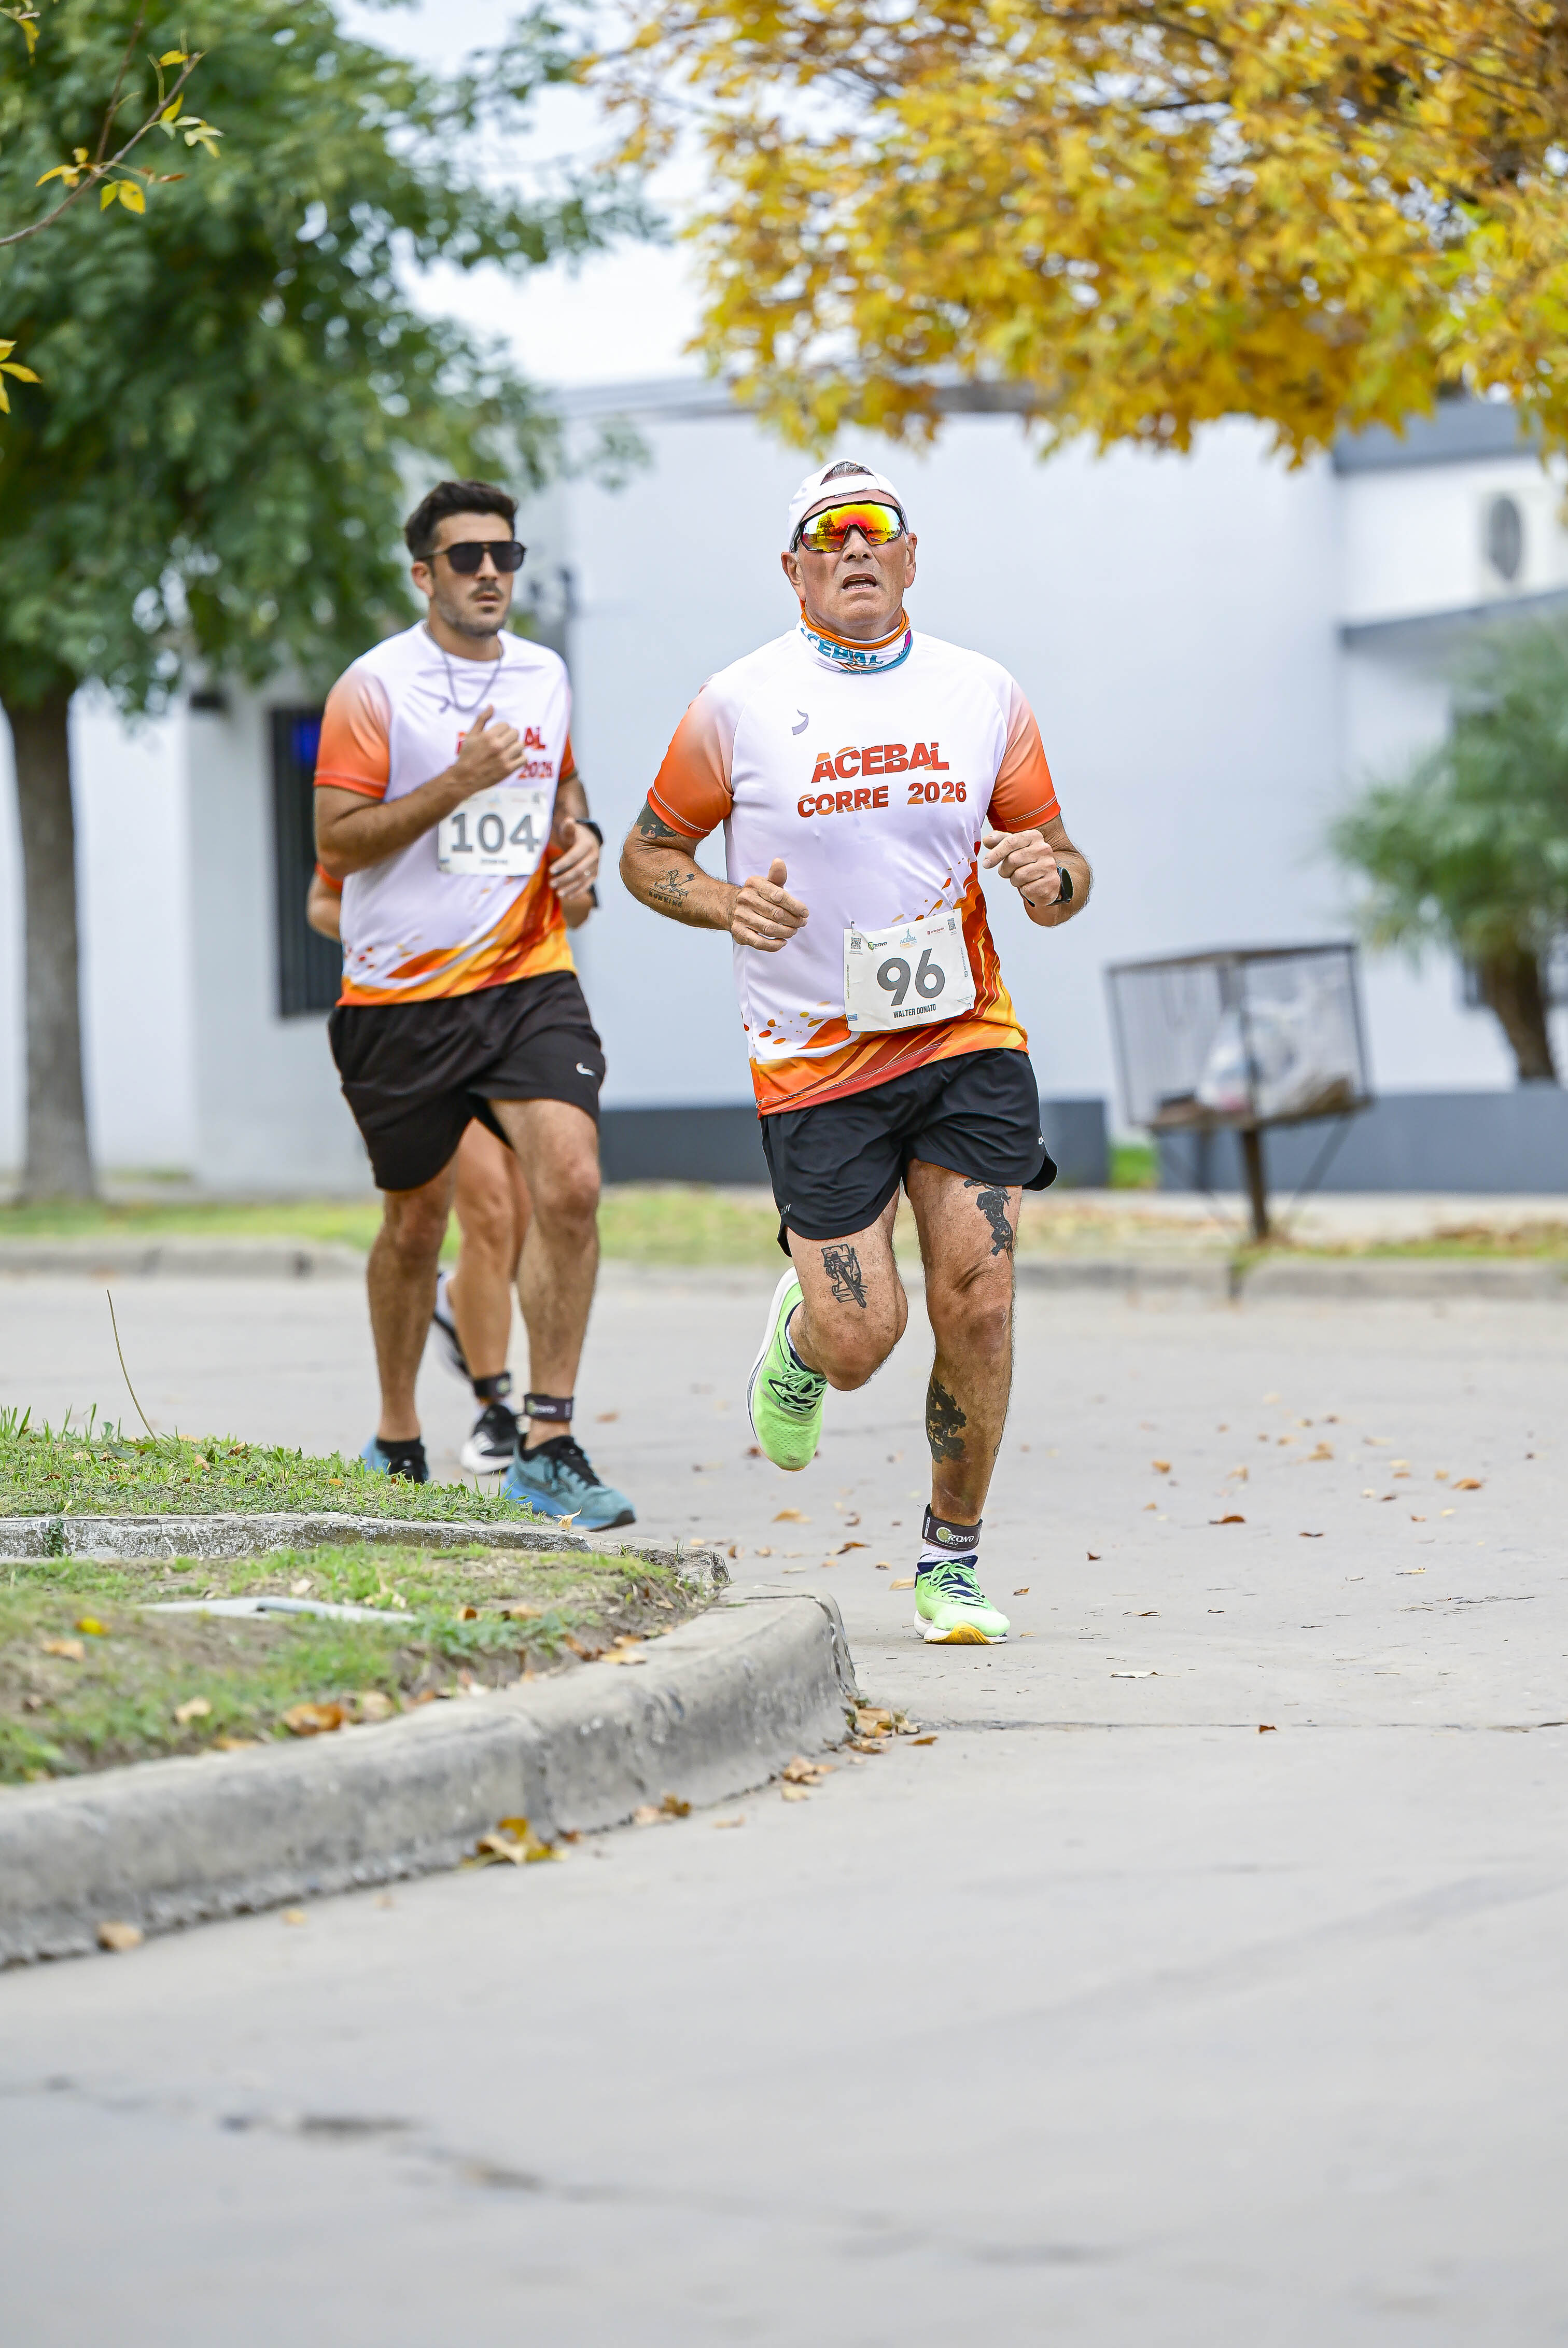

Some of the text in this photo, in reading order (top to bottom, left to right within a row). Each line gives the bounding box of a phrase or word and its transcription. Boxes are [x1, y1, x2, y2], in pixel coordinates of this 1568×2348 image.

[811, 742, 949, 783] ACEBAL
[797, 781, 967, 818] CORRE 2026
[452, 813, 539, 853] 104
[877, 948, 945, 1006] 96
[893, 1004, 936, 1018] WALTER DONATO
